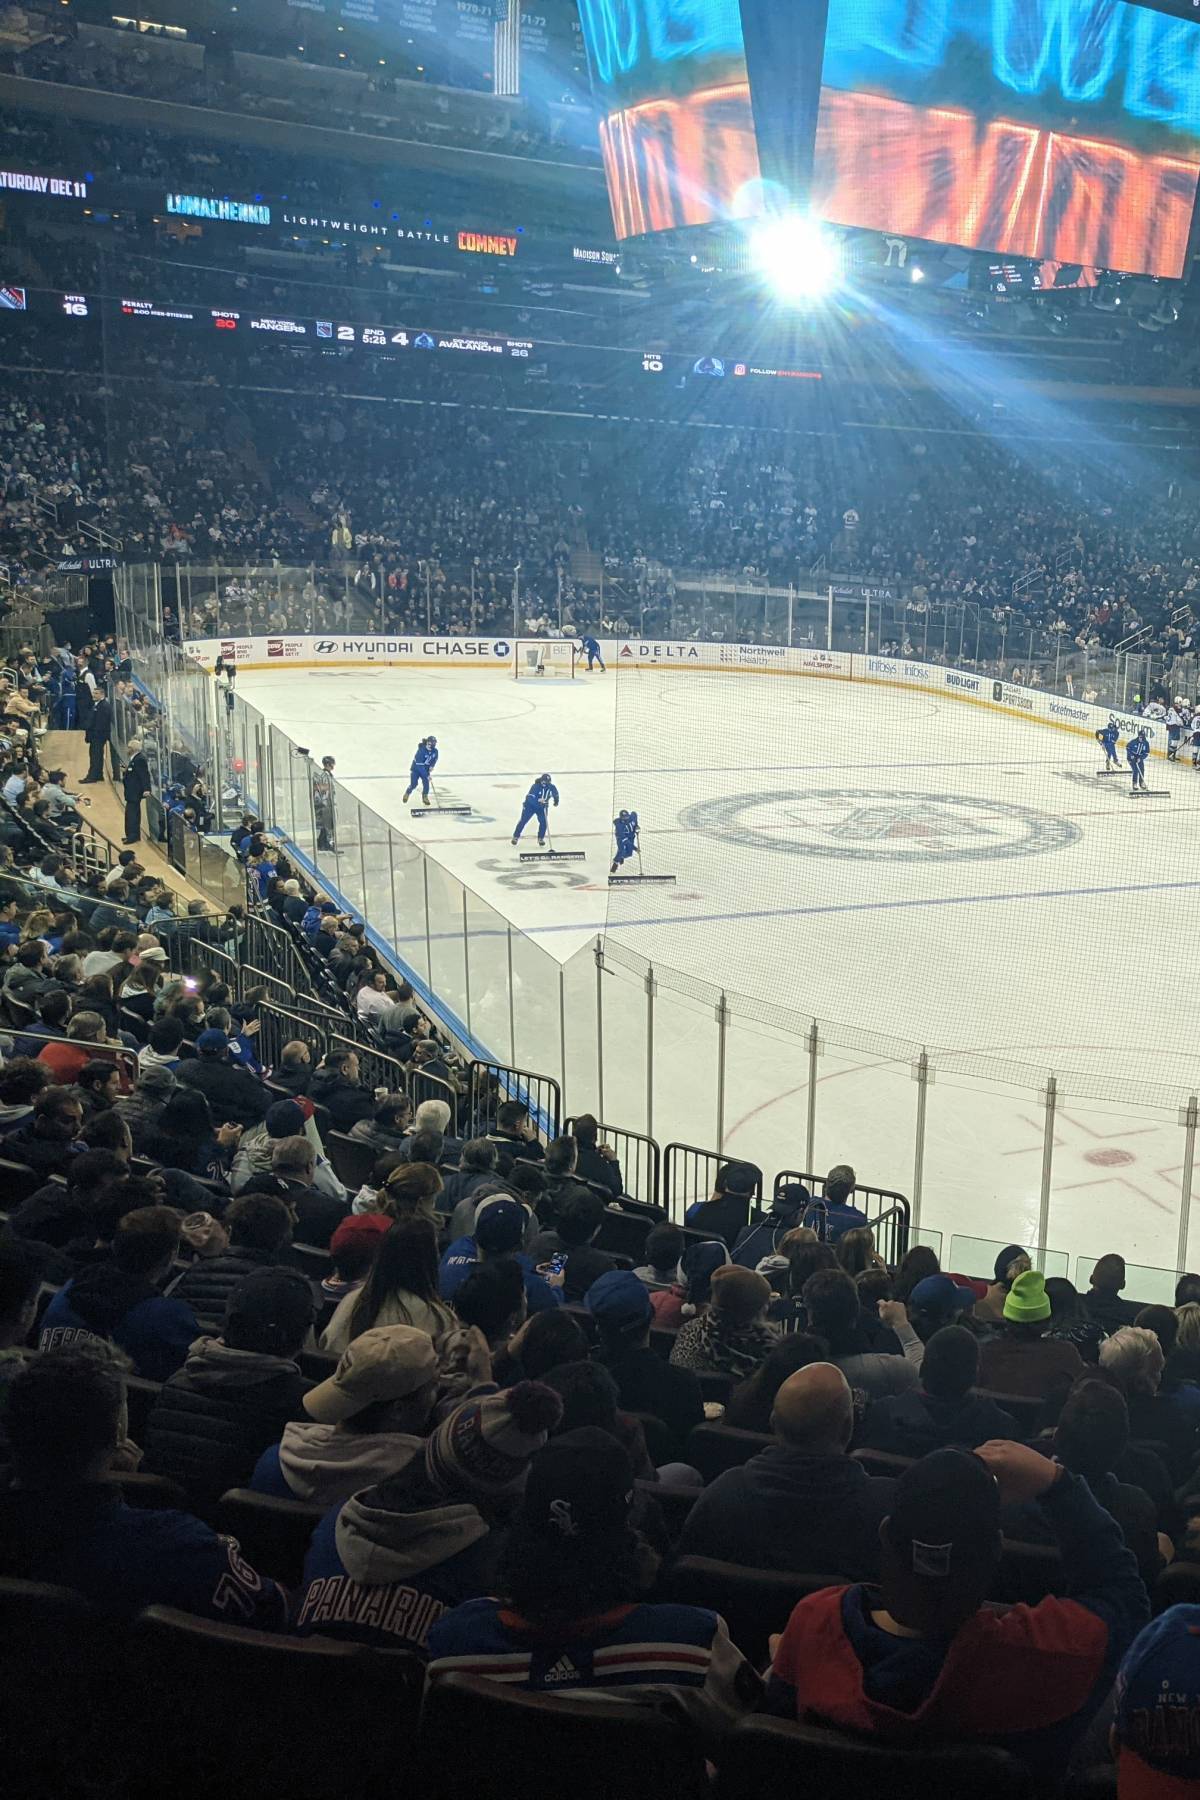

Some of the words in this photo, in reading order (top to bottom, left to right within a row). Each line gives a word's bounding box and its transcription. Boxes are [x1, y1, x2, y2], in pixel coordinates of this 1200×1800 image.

[50, 178, 73, 196] DEC
[73, 182, 87, 198] 11
[283, 214, 388, 236] LIGHTWEIGHT
[398, 229, 450, 243] BATTLE
[457, 231, 518, 256] COMMEY
[65, 295, 86, 303] HITS
[122, 300, 153, 309] PENALTY
[63, 303, 88, 316] 16
[211, 311, 240, 319] SHOTS
[215, 319, 236, 329] 20
[251, 321, 306, 334] RANGERS
[337, 326, 355, 341] 2
[364, 328, 385, 337] 2ND
[362, 335, 387, 345] 5:28
[391, 332, 409, 346] 4
[507, 341, 533, 349] SHOTS
[438, 340, 503, 353] AVALANCHE
[511, 349, 529, 358] 26
[642, 360, 663, 372] 10
[750, 368, 777, 376] FOLLOW
[88, 559, 118, 569] ULTRA
[861, 588, 892, 599] ULTRA
[343, 642, 413, 654] HYUNDAI
[422, 642, 489, 656] CHASE
[639, 645, 699, 657] DELTA
[739, 645, 786, 657] Northwell
[739, 656, 769, 665] Health
[868, 659, 898, 676] Infosys
[904, 663, 930, 680] Infosys
[946, 673, 961, 686] BUD
[961, 677, 980, 692] LIGHT
[1003, 693, 1033, 711] SPORTSBOOK
[1050, 702, 1090, 722] ticketmaster
[544, 1670, 581, 1683] adidas
[1158, 1693, 1188, 1703] NEW
